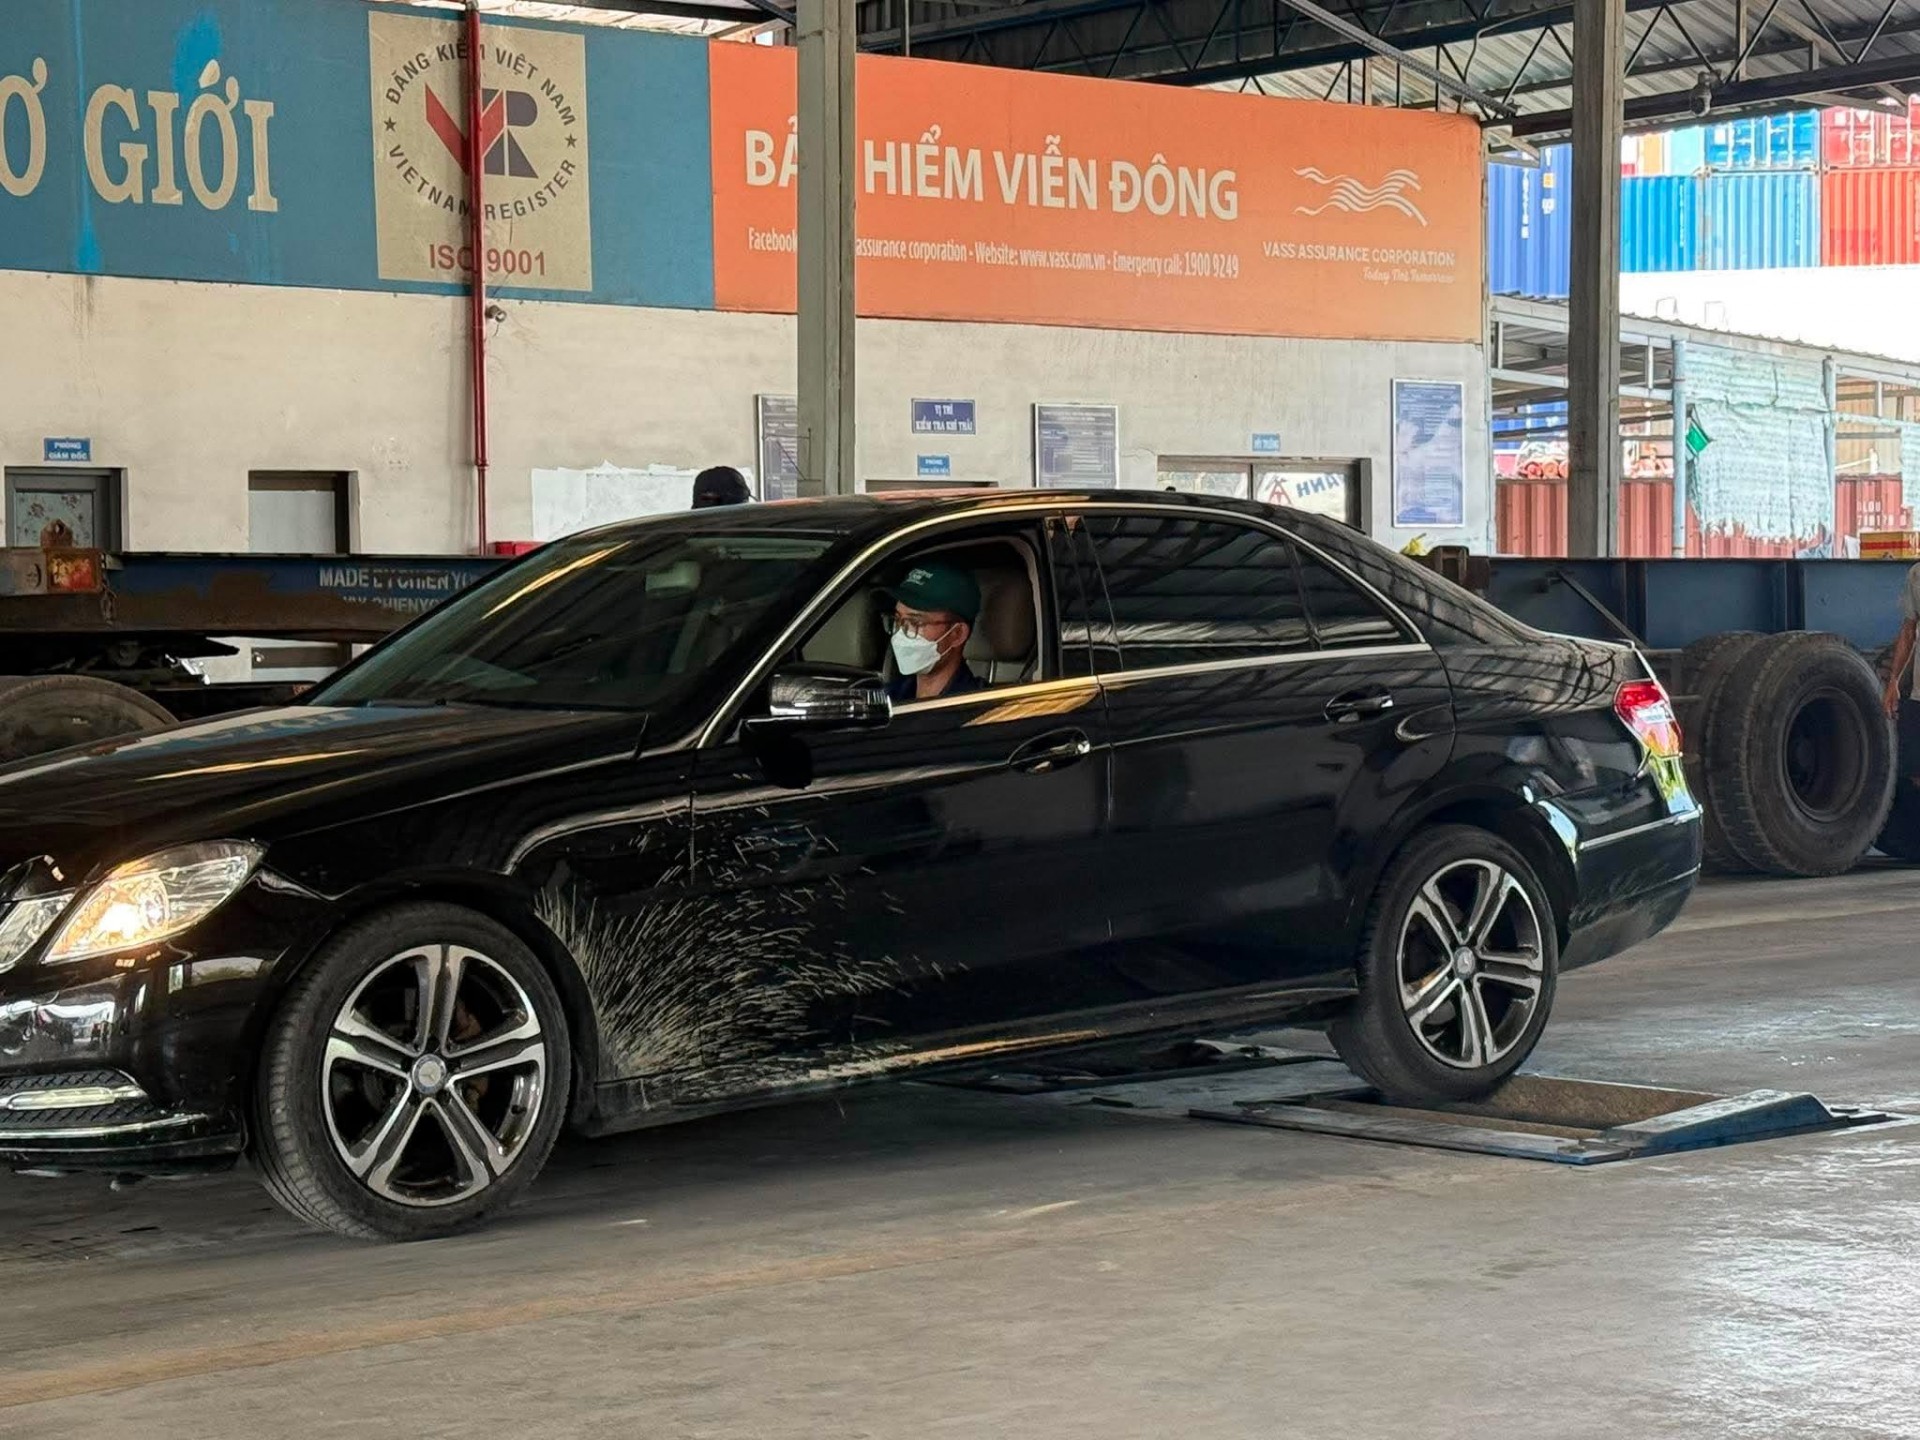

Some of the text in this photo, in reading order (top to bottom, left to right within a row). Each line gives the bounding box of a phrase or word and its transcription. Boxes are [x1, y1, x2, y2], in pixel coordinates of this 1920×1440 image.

[385, 37, 576, 126] ĐĂNG KIỂ VIỆT NAM
[0, 57, 278, 212] Ơ GIỚI
[389, 144, 576, 221] VIETNAM REGISTER
[745, 115, 1239, 221] BẢ HIỂM VIỄN ĐÔNG
[429, 244, 546, 276] ISO 9001
[908, 238, 968, 265] corporation
[975, 241, 1018, 267] Website:
[1019, 249, 1106, 271] www.vass.com.vn
[1112, 250, 1163, 278] Emergency
[1164, 251, 1183, 276] call:
[1184, 251, 1211, 277] 1900
[1212, 252, 1240, 279] 9249
[1263, 241, 1456, 268] VASS ASSURANCE CORPORATION
[319, 567, 369, 588] MADE
